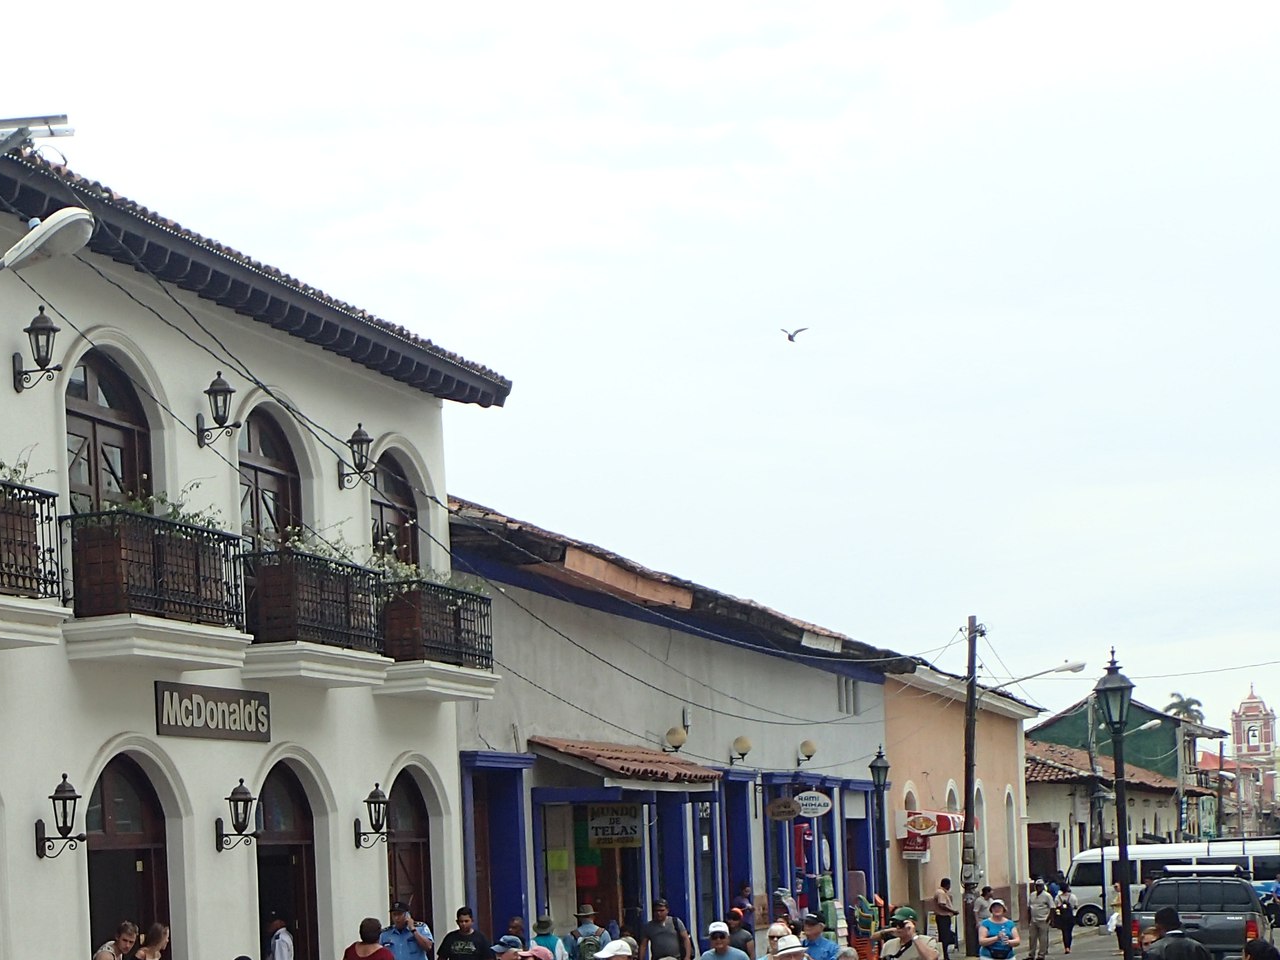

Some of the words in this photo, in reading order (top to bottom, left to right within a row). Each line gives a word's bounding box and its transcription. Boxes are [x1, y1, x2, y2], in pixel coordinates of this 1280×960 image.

[162, 690, 269, 733] McDonald's
[590, 805, 638, 820] MUNDO
[609, 817, 622, 825] DE
[591, 825, 638, 836] TELAS
